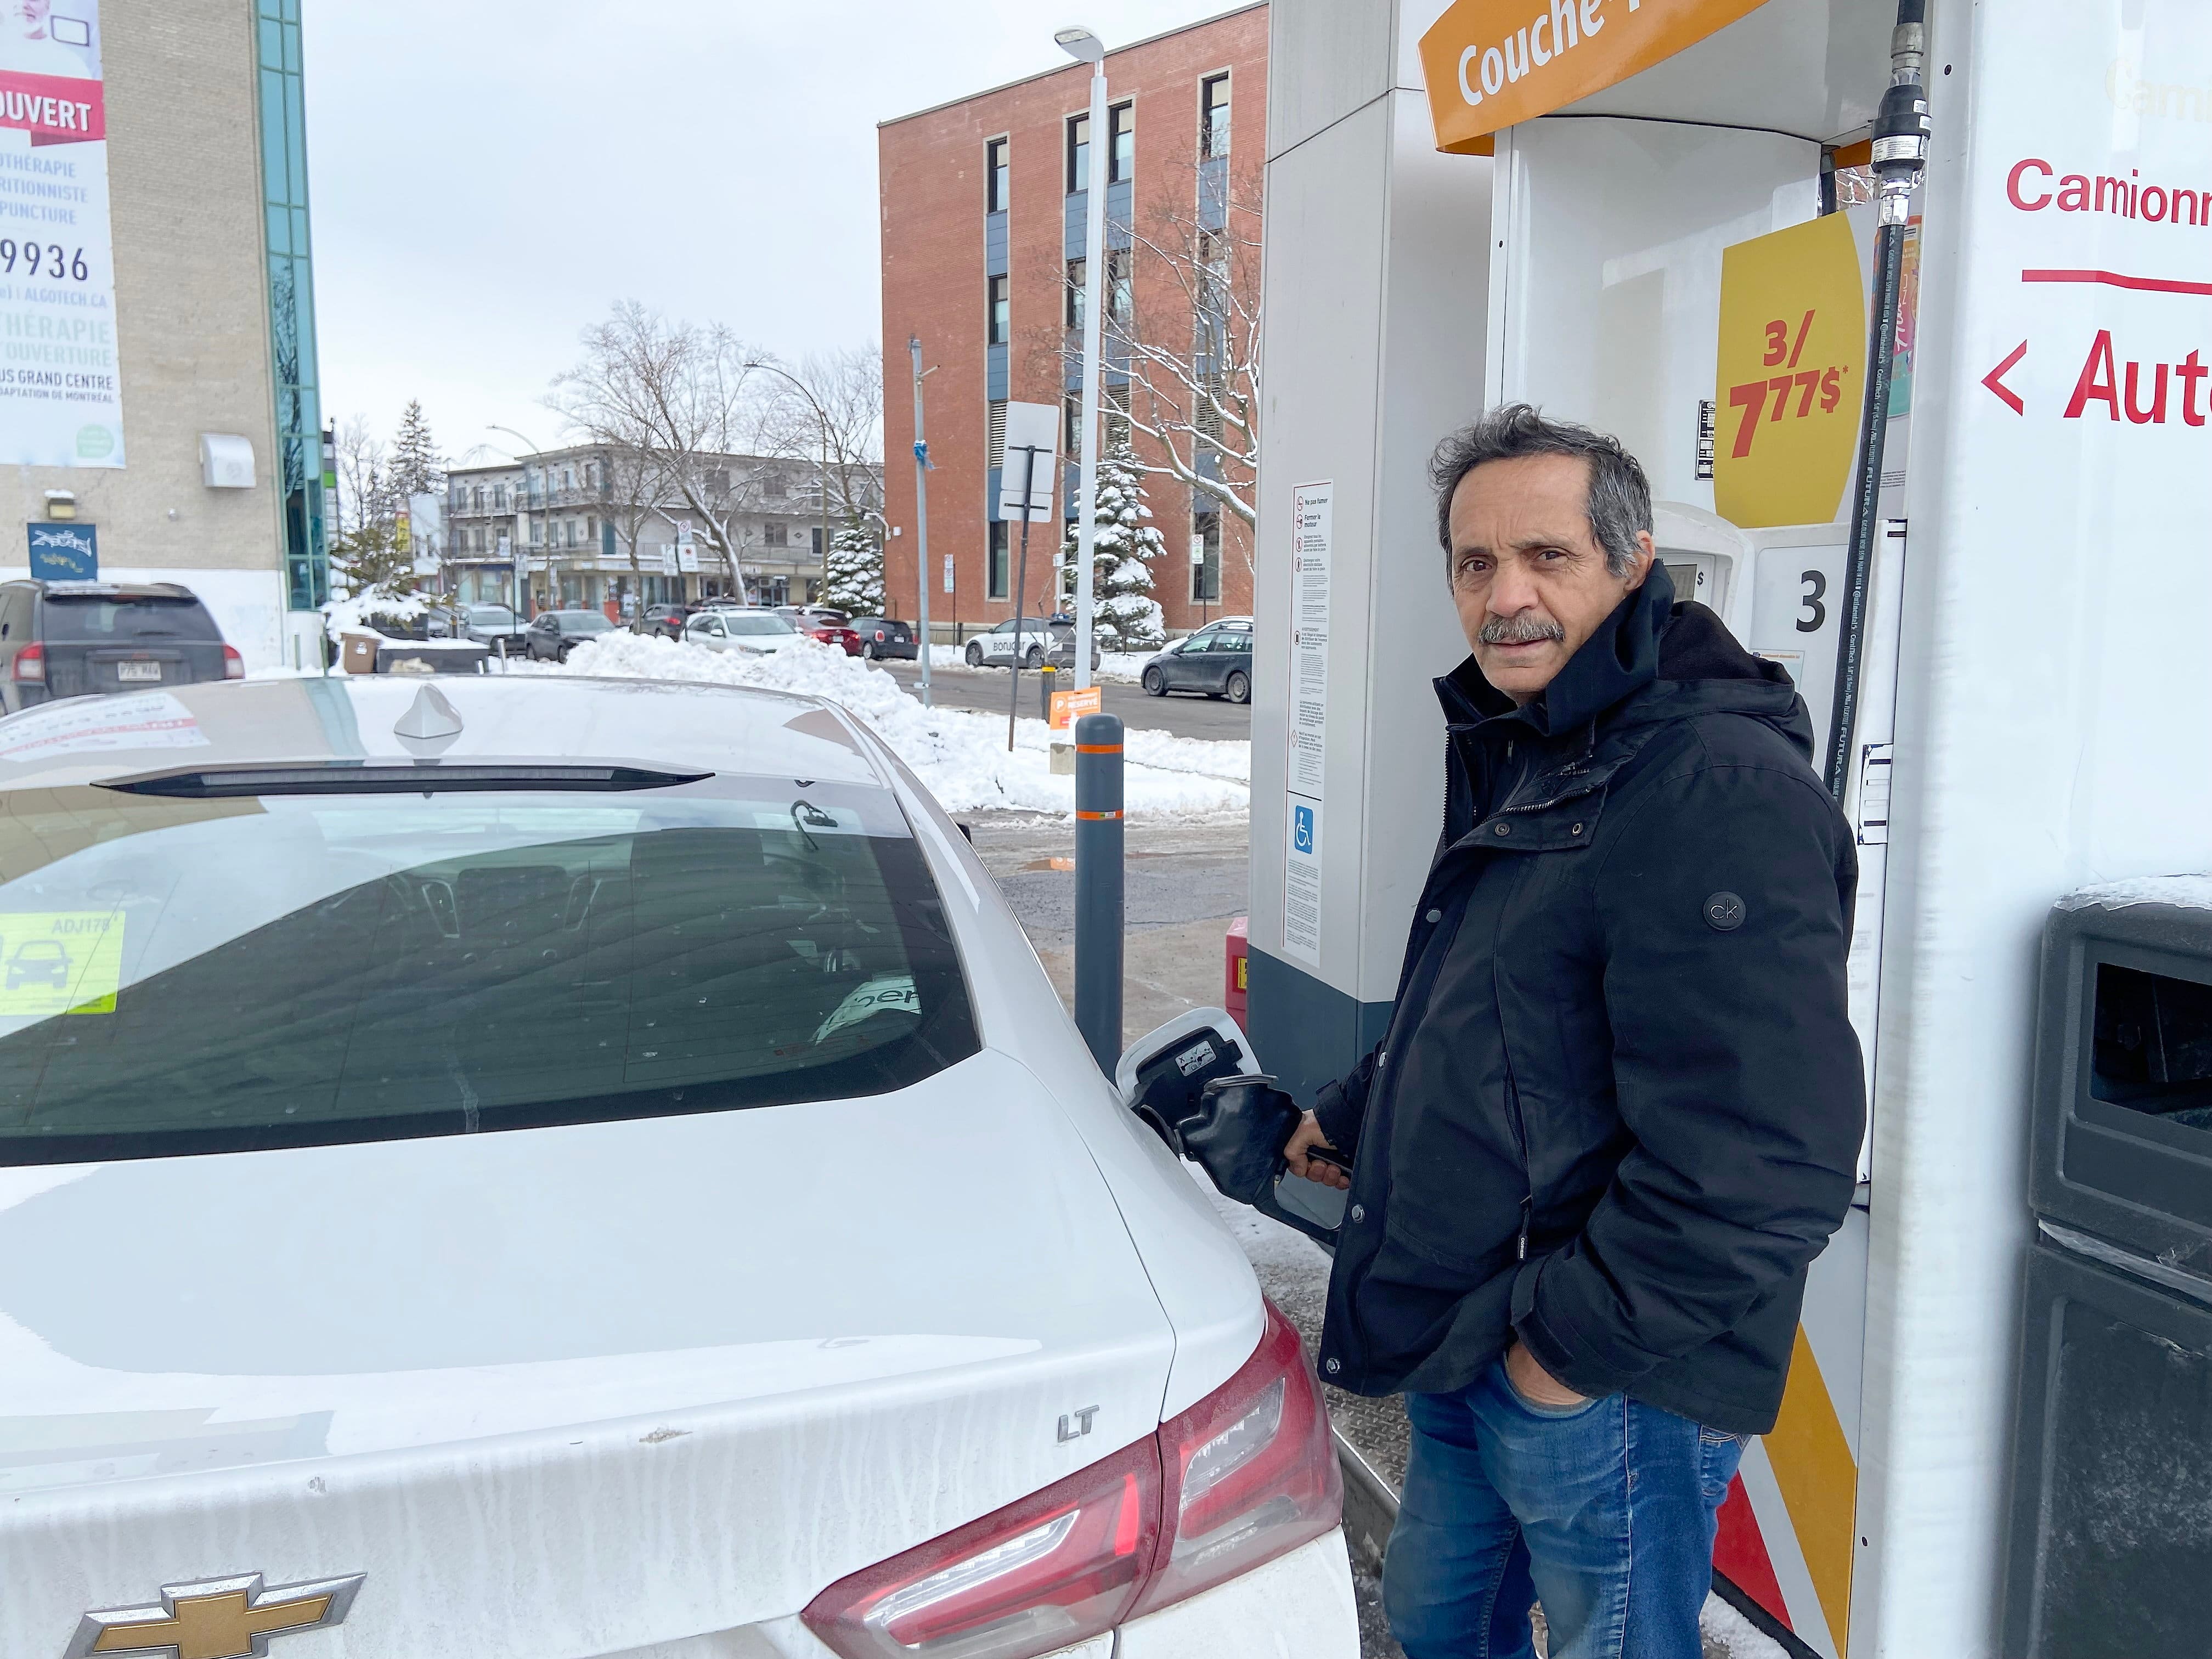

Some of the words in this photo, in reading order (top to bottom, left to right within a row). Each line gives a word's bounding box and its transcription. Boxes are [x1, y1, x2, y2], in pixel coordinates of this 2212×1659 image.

[1458, 0, 1640, 106] Couche
[0, 239, 88, 281] 9936
[0, 308, 110, 344] HÉRAPIE
[1763, 309, 1816, 369] 3/
[18, 369, 62, 388] GRAND
[65, 373, 114, 391] CENTRE
[2063, 329, 2212, 426] Aut
[1862, 466, 1874, 517] FUTURA
[1796, 569, 1826, 633] 3
[1848, 634, 1857, 663] ContiTech
[1835, 726, 1847, 775] FUTURA
[1057, 1404, 1100, 1443] LT
